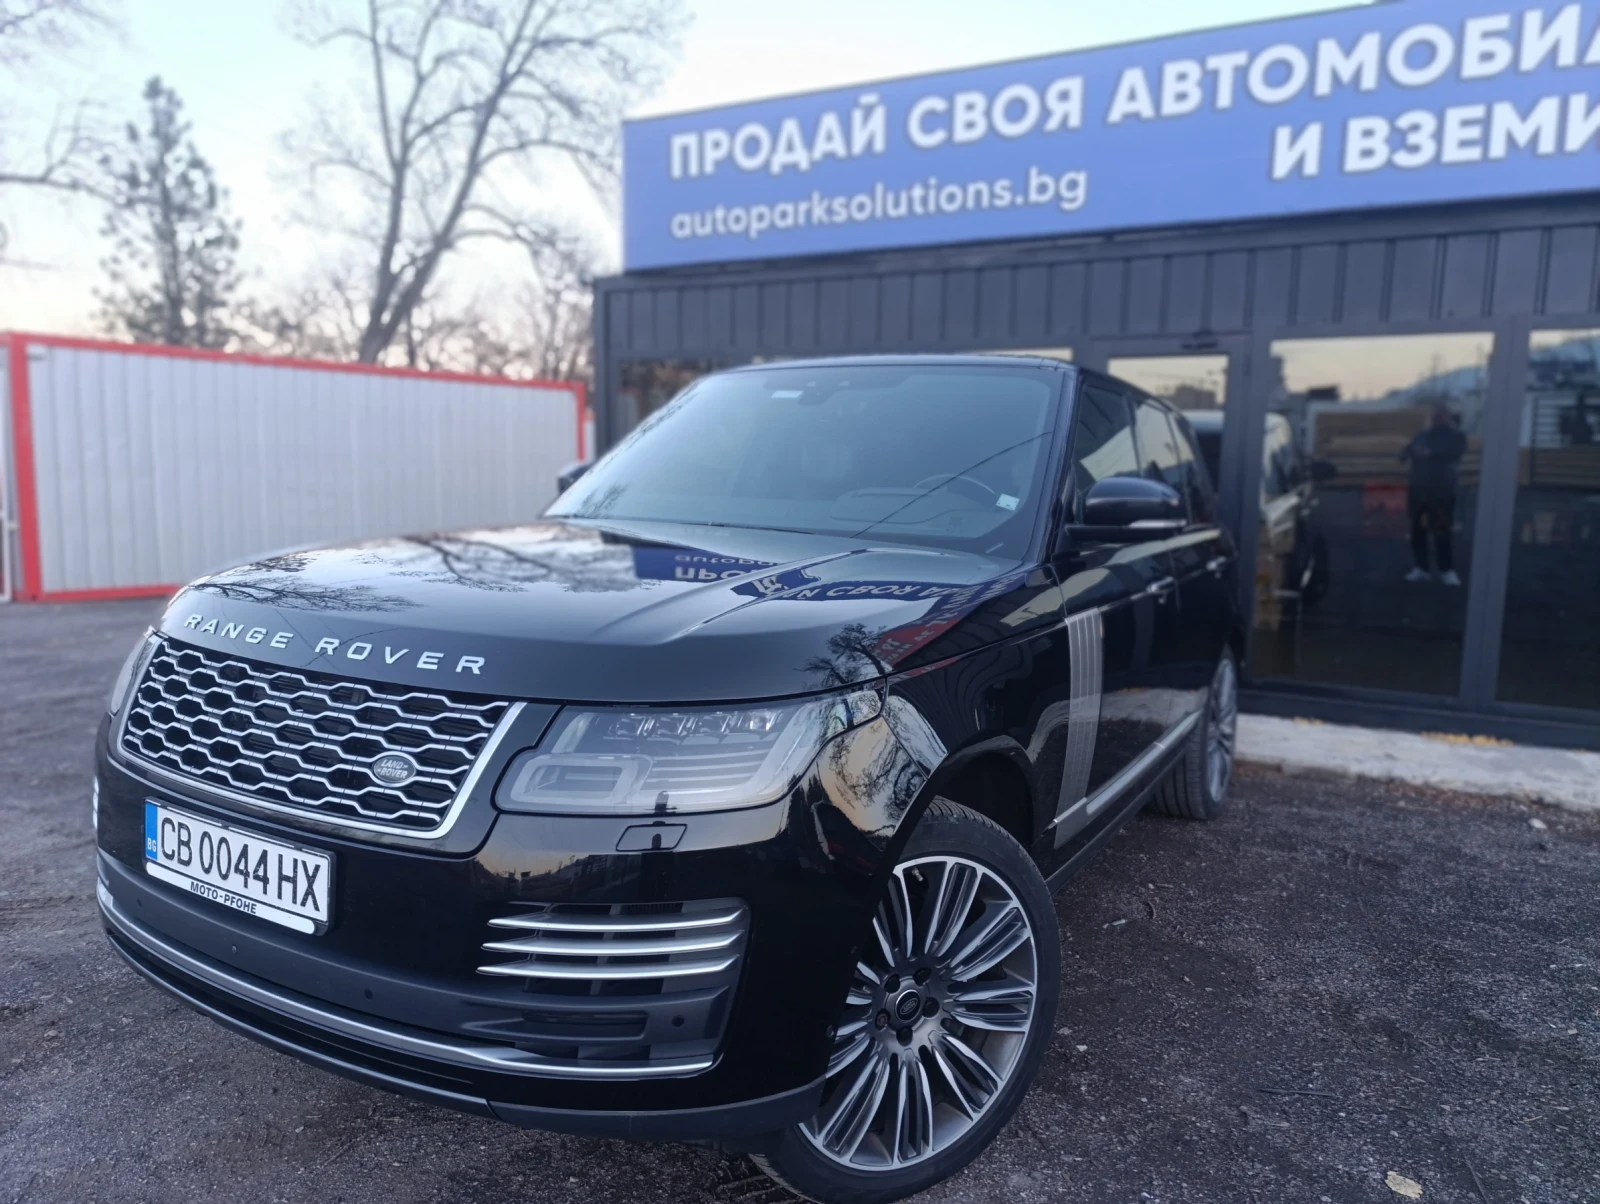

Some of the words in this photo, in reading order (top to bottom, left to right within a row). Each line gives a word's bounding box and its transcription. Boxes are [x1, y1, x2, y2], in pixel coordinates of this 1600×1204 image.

[670, 93, 887, 179] ПРОДАЙ
[907, 76, 1084, 148] СВОЯ
[1106, 3, 1600, 124] АВТОМОБИ
[1271, 121, 1323, 180] И
[670, 166, 1087, 240] autoparksolutions.bg
[184, 613, 294, 649] RANGE
[314, 637, 486, 675] ROVER
[380, 767, 408, 779] ROVER
[381, 759, 404, 769] LAND
[147, 837, 157, 853] BG
